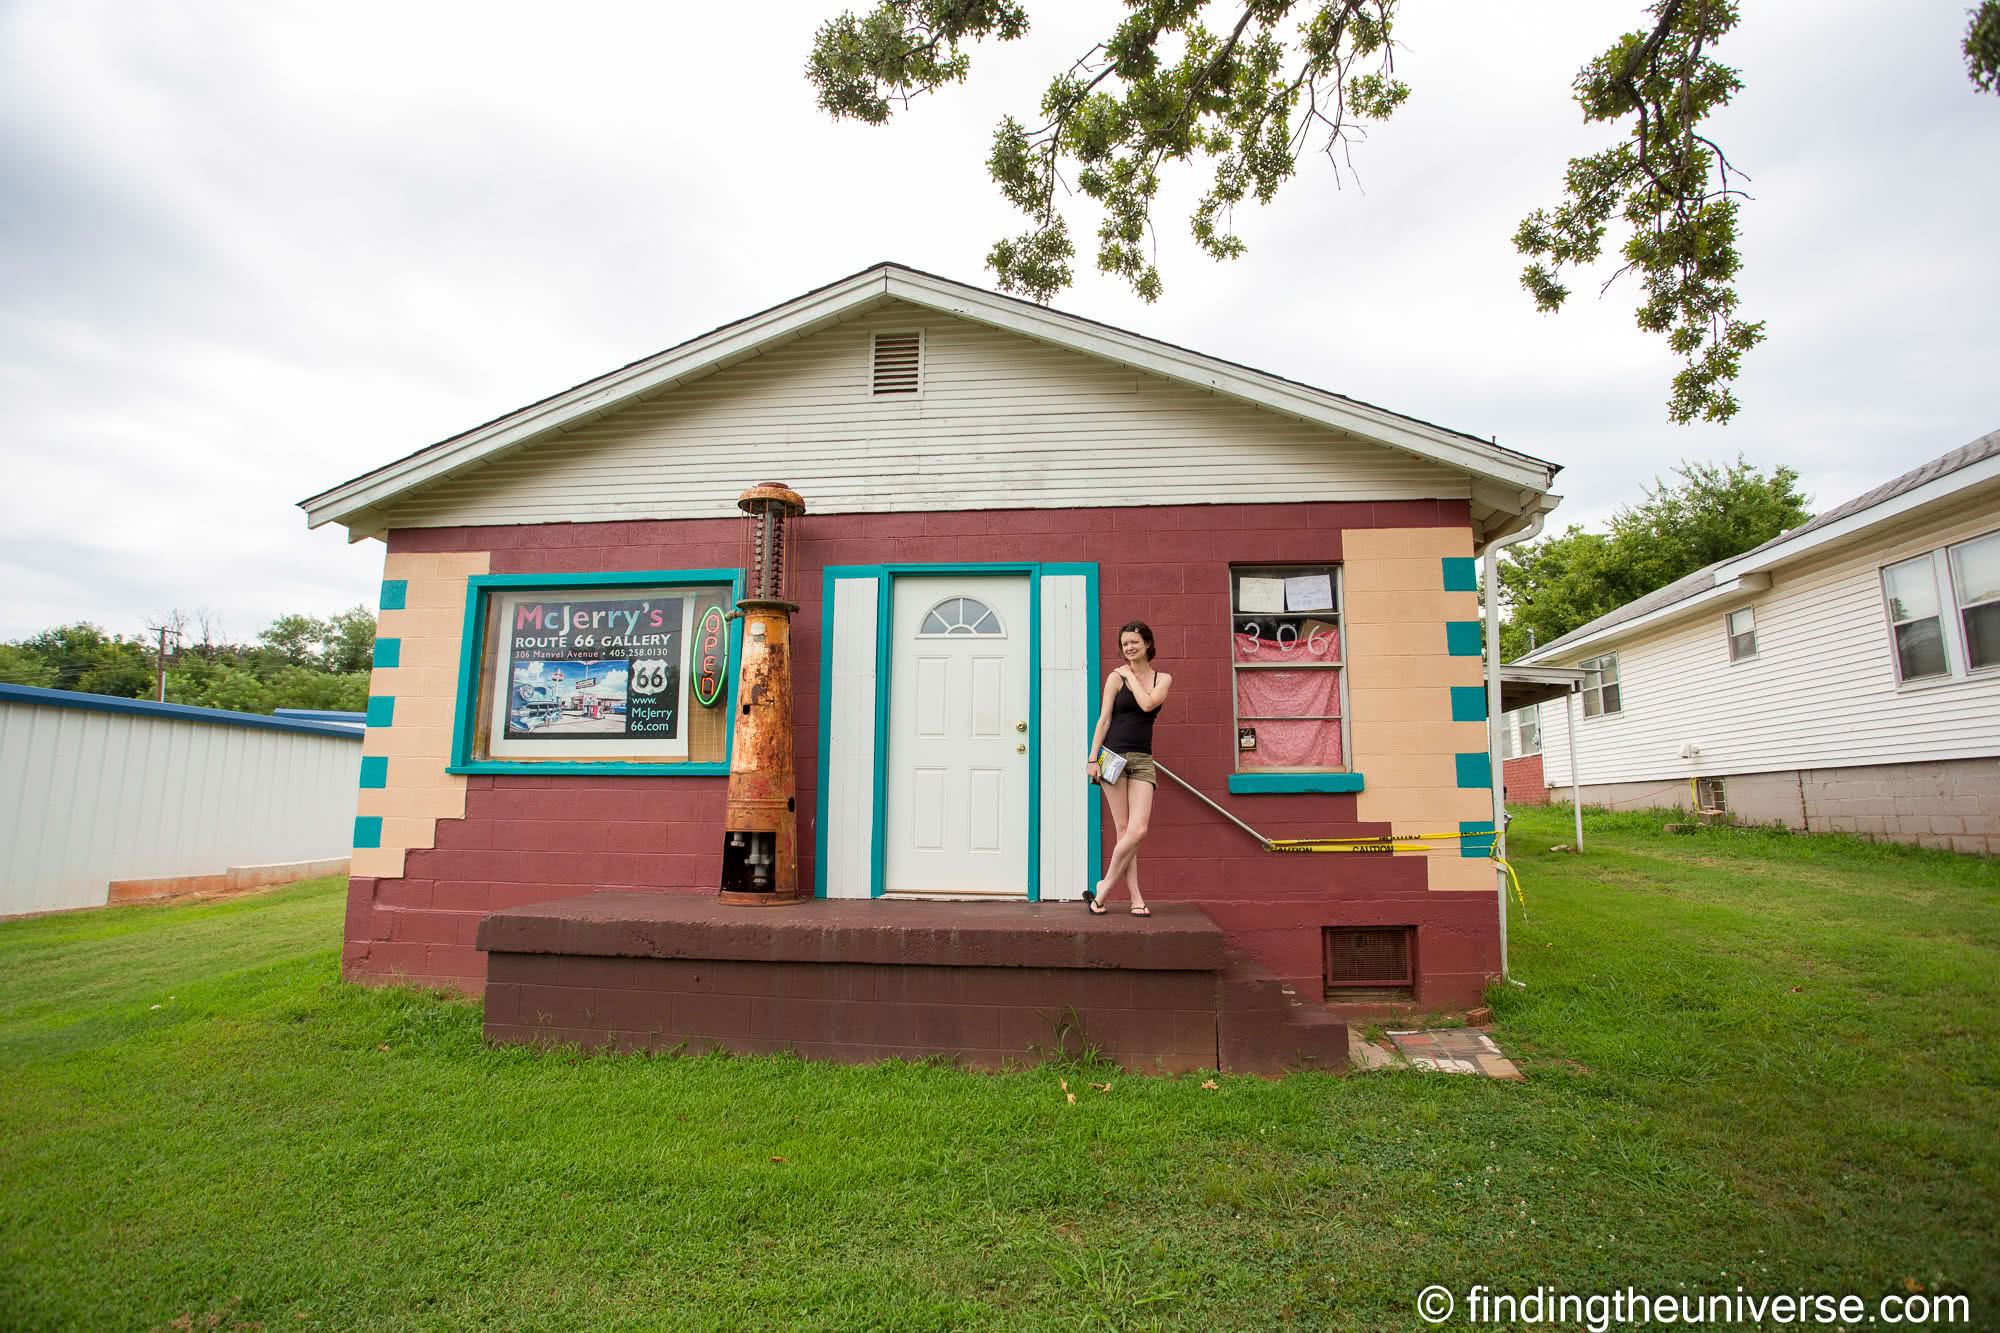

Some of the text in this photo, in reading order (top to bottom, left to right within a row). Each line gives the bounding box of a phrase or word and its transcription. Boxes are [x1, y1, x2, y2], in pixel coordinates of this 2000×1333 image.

[516, 601, 664, 636] McJerry's
[515, 633, 671, 648] ROUTE 66 GALLERY
[1241, 622, 1329, 656] 306
[515, 648, 668, 658] 306 Manvel Avenue 405.258.0130
[637, 666, 663, 688] 66
[631, 697, 657, 705] www.
[631, 708, 673, 720] McJerry
[630, 721, 669, 732] 66.com
[1352, 845, 1394, 853] CAUTION
